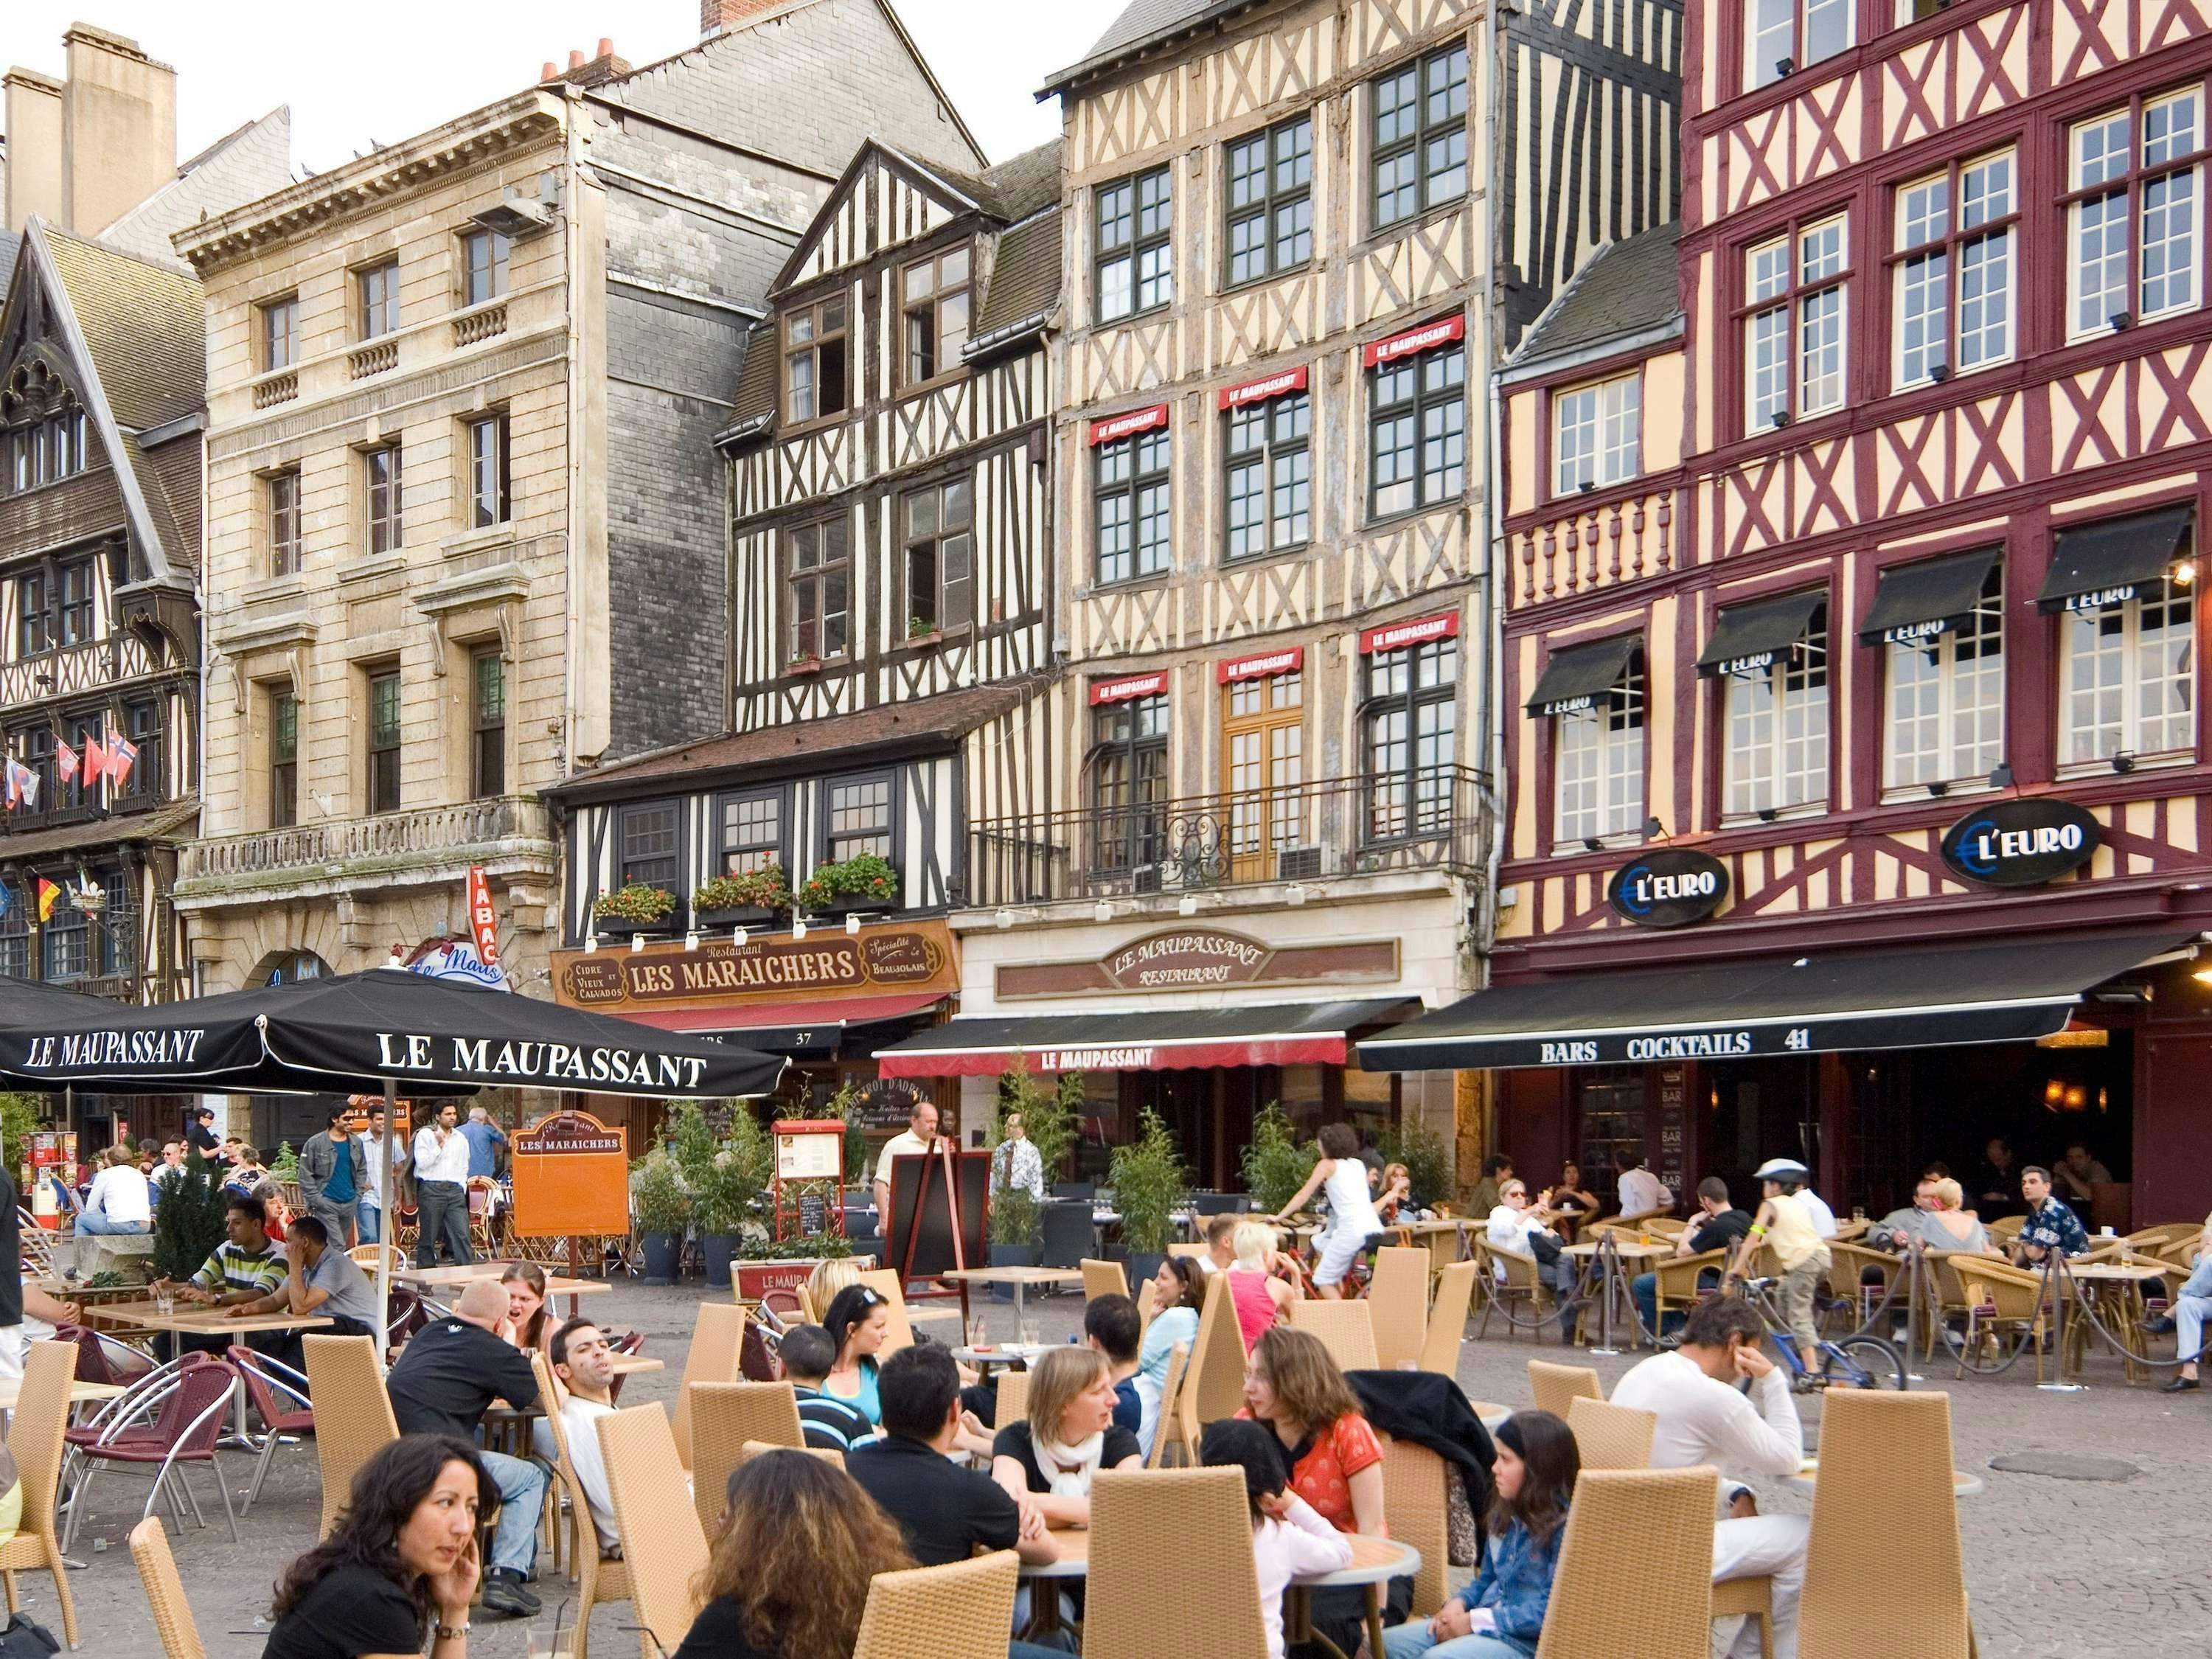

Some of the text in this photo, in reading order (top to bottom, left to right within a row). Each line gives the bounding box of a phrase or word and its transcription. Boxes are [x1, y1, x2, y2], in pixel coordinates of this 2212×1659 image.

[1377, 324, 1451, 357] LE MAUPASSANT
[1229, 374, 1295, 402] LE MAUPASSANT
[1098, 411, 1158, 437] LE MAUPASSANT
[1373, 620, 1447, 646] LE MAUPASSANT
[1228, 653, 1294, 676] LE MAUPASSANT
[1099, 676, 1160, 698] LE MAUPASSANT
[1978, 824, 2082, 860] L'EURO
[1636, 870, 1716, 903] L'EURO
[473, 869, 496, 961] TABAC
[706, 942, 762, 958] Restaurant
[1114, 936, 1263, 975] LE MAUPASSANT
[630, 950, 855, 993] LES MARAICHERS
[1140, 965, 1232, 985] RESTAURANT
[22, 1029, 204, 1067] LE MAUPASSANT
[796, 1033, 811, 1046] 37
[1540, 1028, 1809, 1063] BARS COCKTAILS 41
[375, 1033, 707, 1088] LE MAUPASSANT
[1041, 1048, 1154, 1070] LE MAUPASSANT
[1662, 1091, 1682, 1102] BAR
[520, 1138, 618, 1150] LES MARAICHERS
[1662, 1131, 1681, 1142] BAR
[1661, 1175, 1681, 1186] BAR
[762, 1276, 773, 1288] LE
